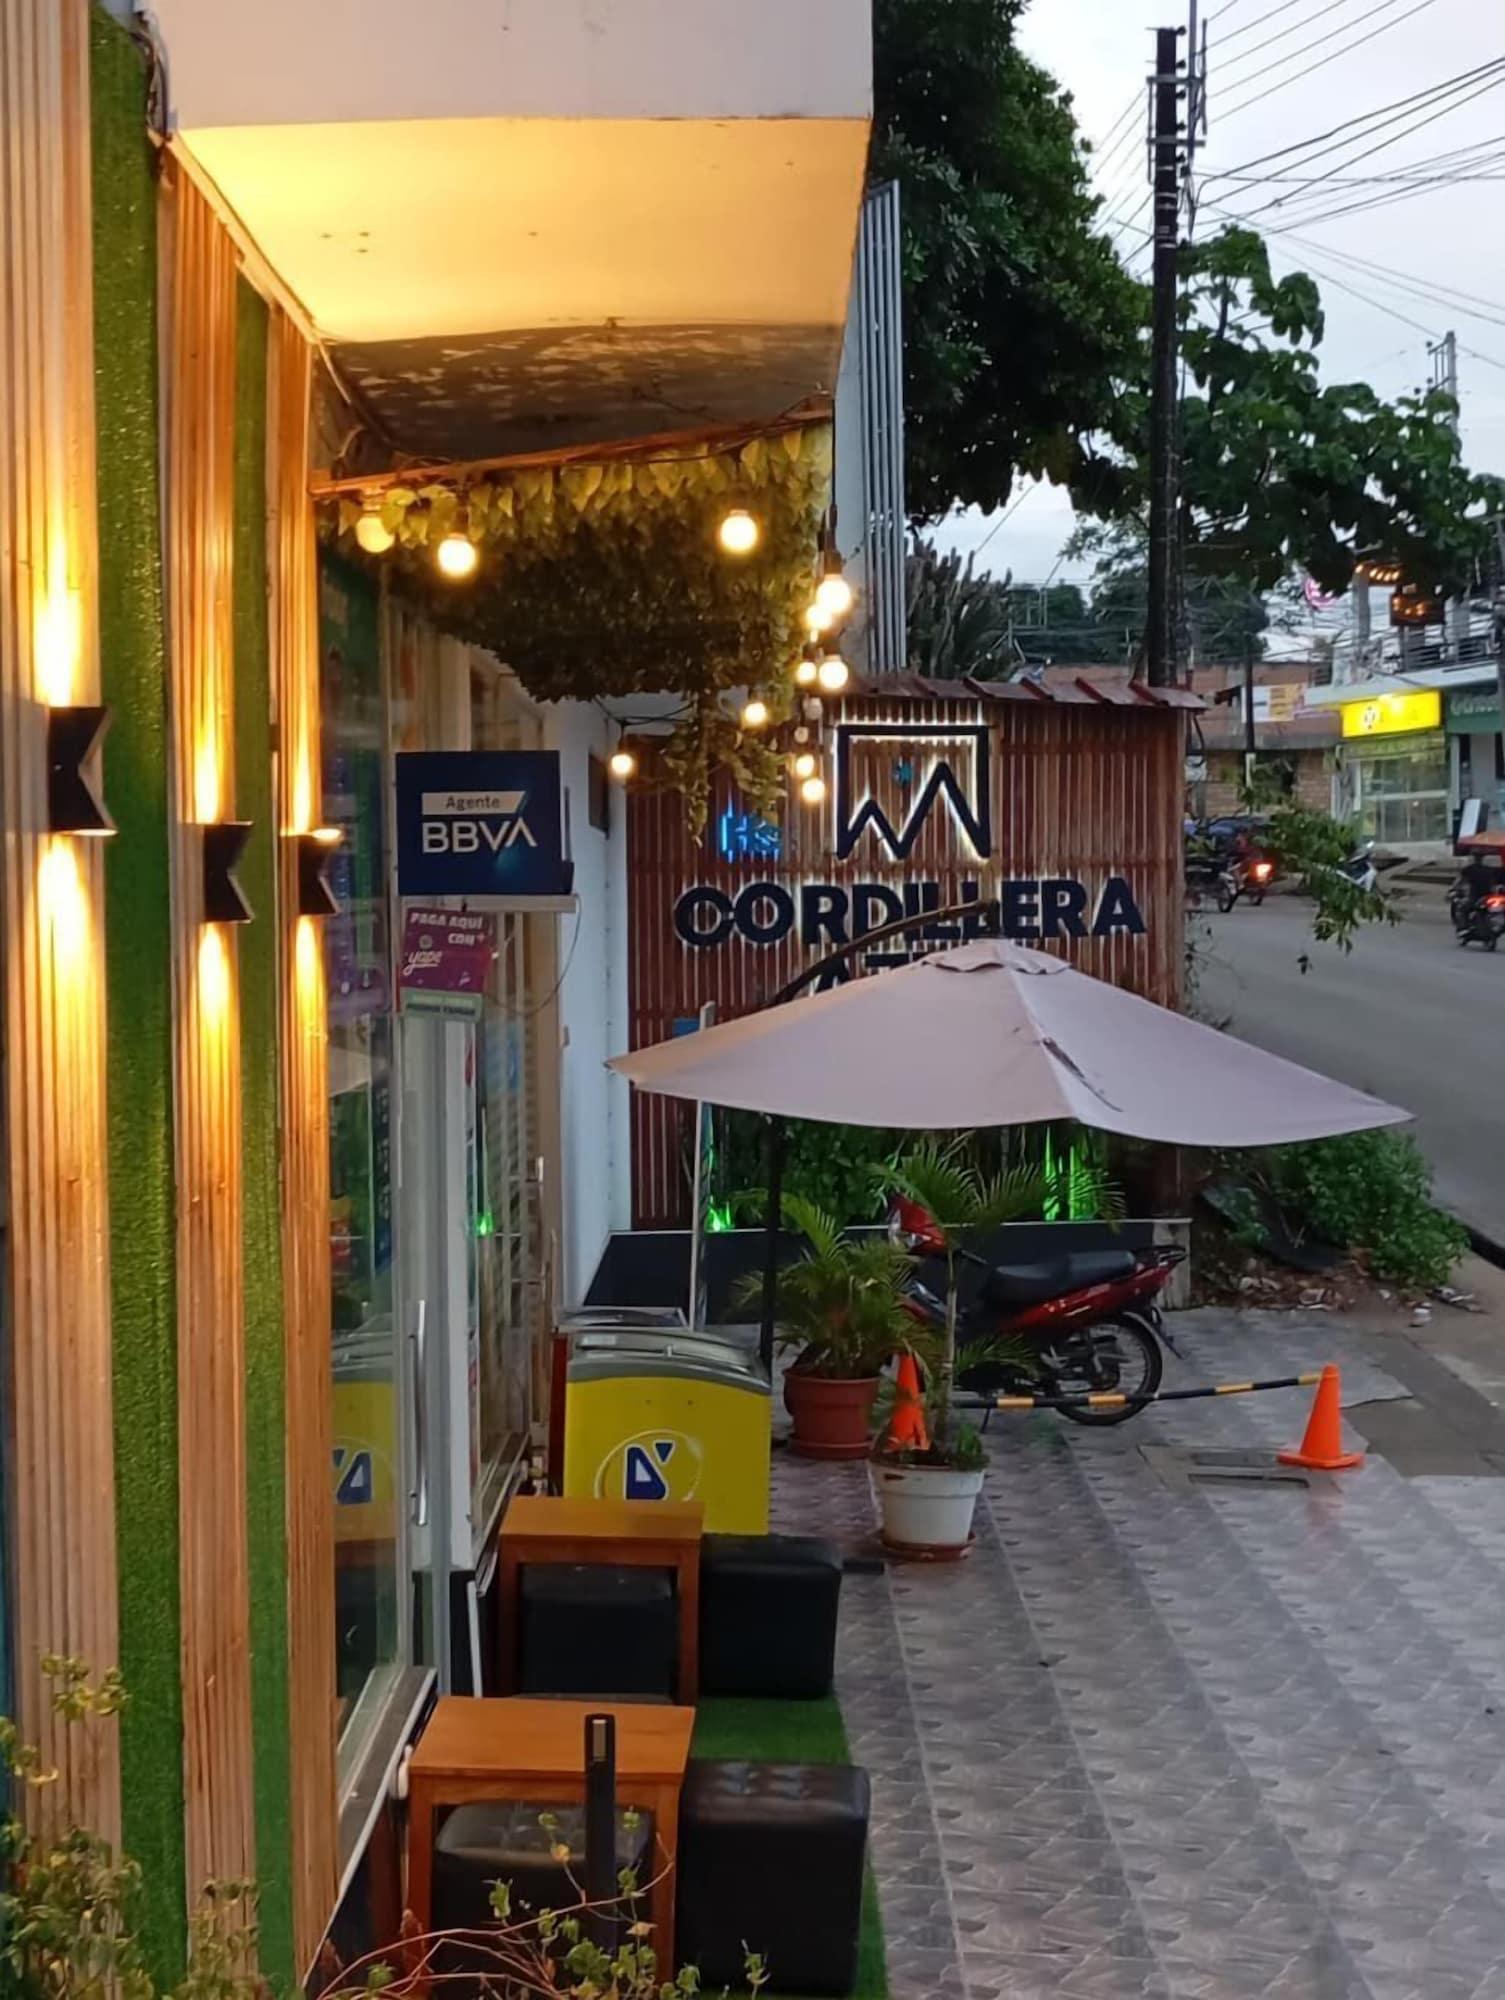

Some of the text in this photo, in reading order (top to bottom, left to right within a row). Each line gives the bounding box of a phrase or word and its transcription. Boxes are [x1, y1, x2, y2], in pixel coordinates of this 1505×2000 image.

[445, 796, 501, 811] Agente
[422, 817, 538, 853] BBVA
[410, 912, 447, 926] PAGA
[674, 876, 1147, 947] CORDILLERA
[448, 932, 476, 945] CON
[402, 950, 442, 976] yape
